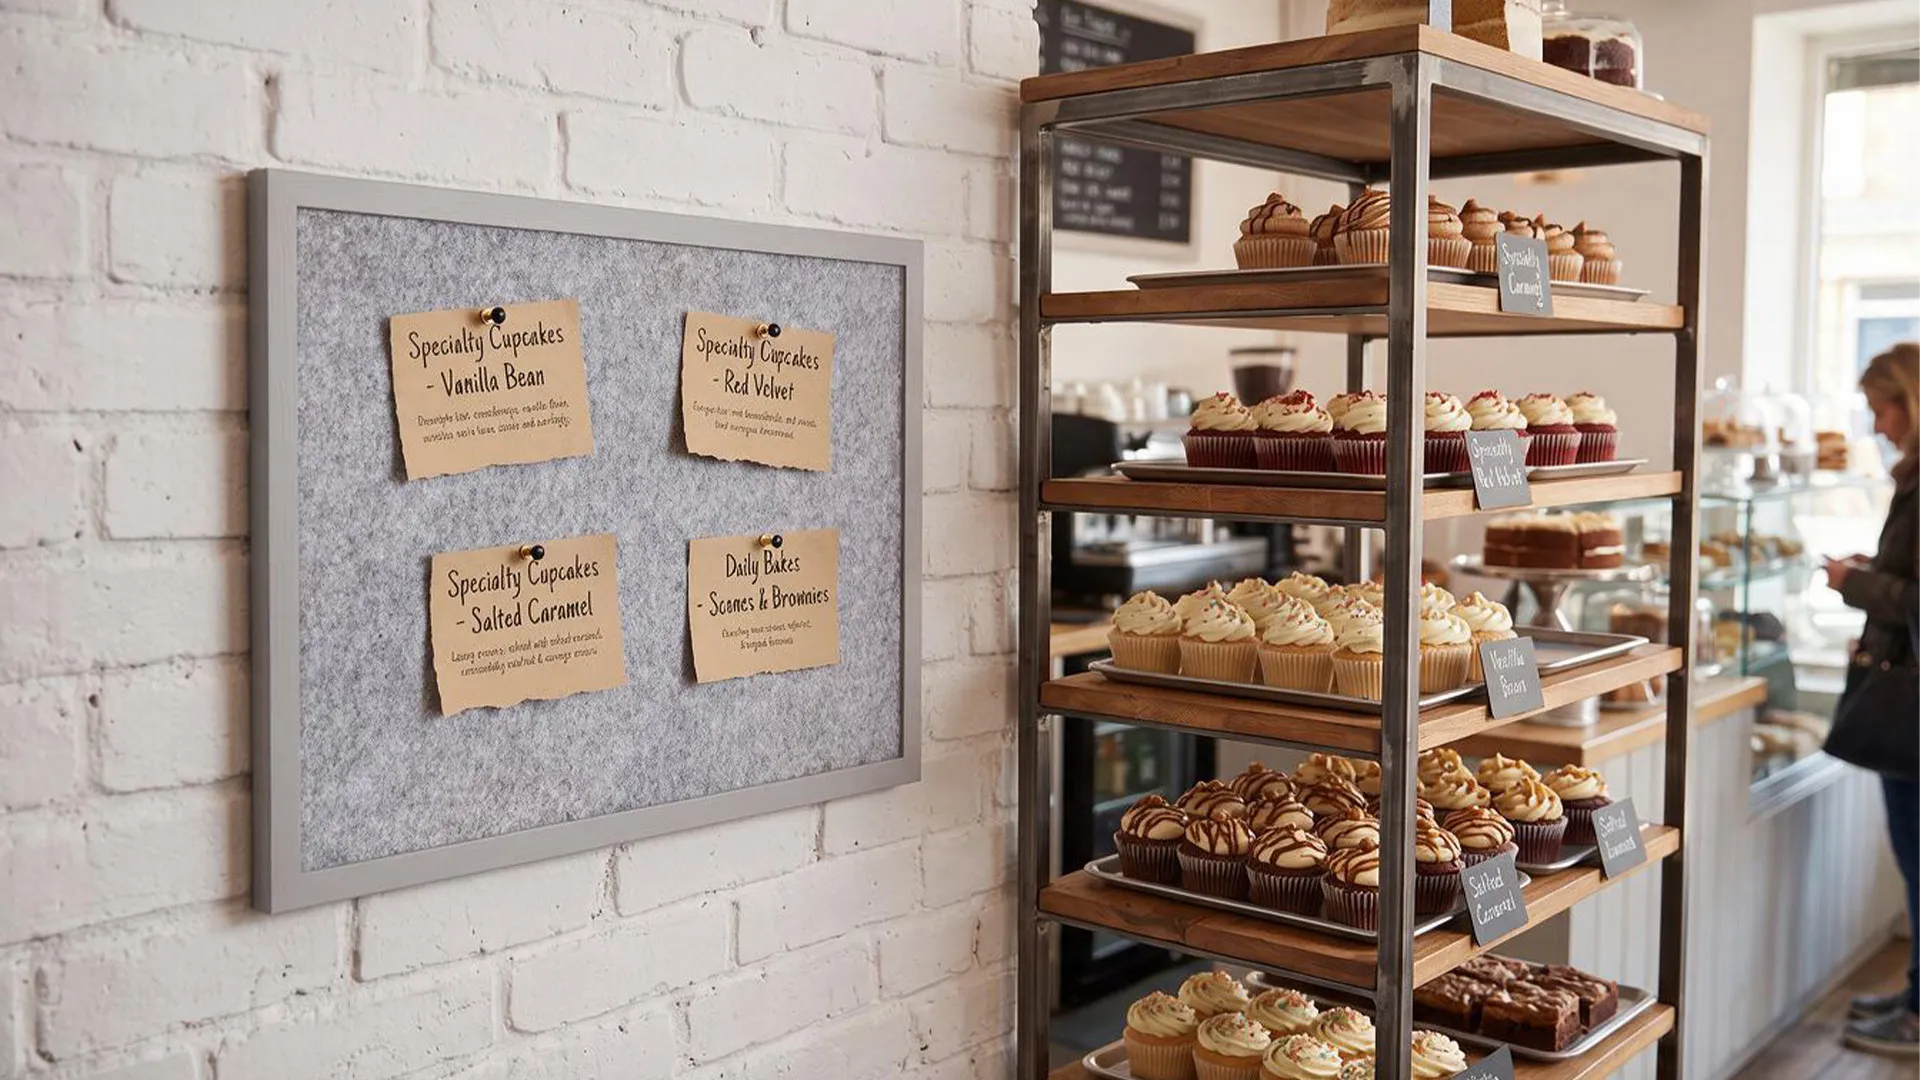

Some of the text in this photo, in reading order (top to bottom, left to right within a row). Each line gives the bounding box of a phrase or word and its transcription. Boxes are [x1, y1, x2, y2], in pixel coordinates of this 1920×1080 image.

[408, 321, 565, 368] Specialty Cupcakes
[696, 327, 819, 373] Specialty Cupcakes
[441, 366, 499, 396] Vanilla
[503, 362, 545, 390] Bean
[725, 368, 749, 395] Red
[753, 373, 794, 401] Velvet
[448, 554, 599, 606] Specialty Cupcakes
[726, 549, 801, 585] Daily Bakes
[472, 602, 521, 634] Salted
[528, 591, 593, 624] Caramel
[772, 584, 829, 609] Brownies
